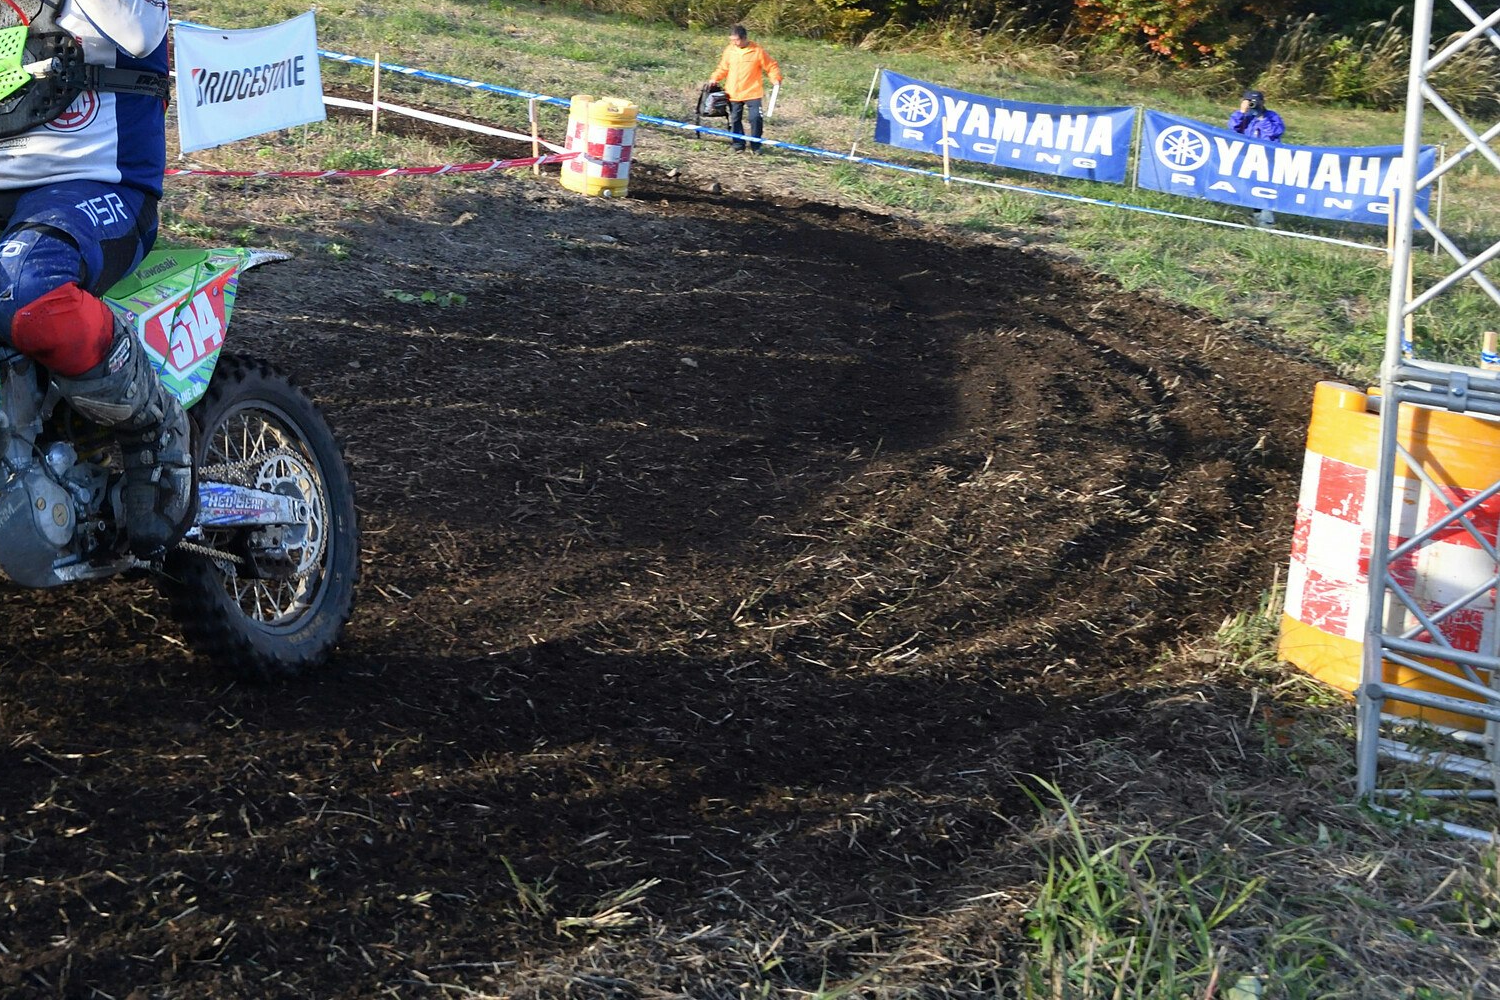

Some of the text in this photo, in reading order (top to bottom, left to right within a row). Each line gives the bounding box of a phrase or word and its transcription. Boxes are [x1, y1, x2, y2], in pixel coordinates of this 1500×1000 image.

[902, 129, 1098, 169] RACING
[943, 96, 1113, 156] YAMAHA
[1213, 137, 1403, 197] YAMAHA
[1171, 173, 1390, 214] RACING
[136, 256, 179, 280] Kawasaki
[158, 290, 223, 369] 514
